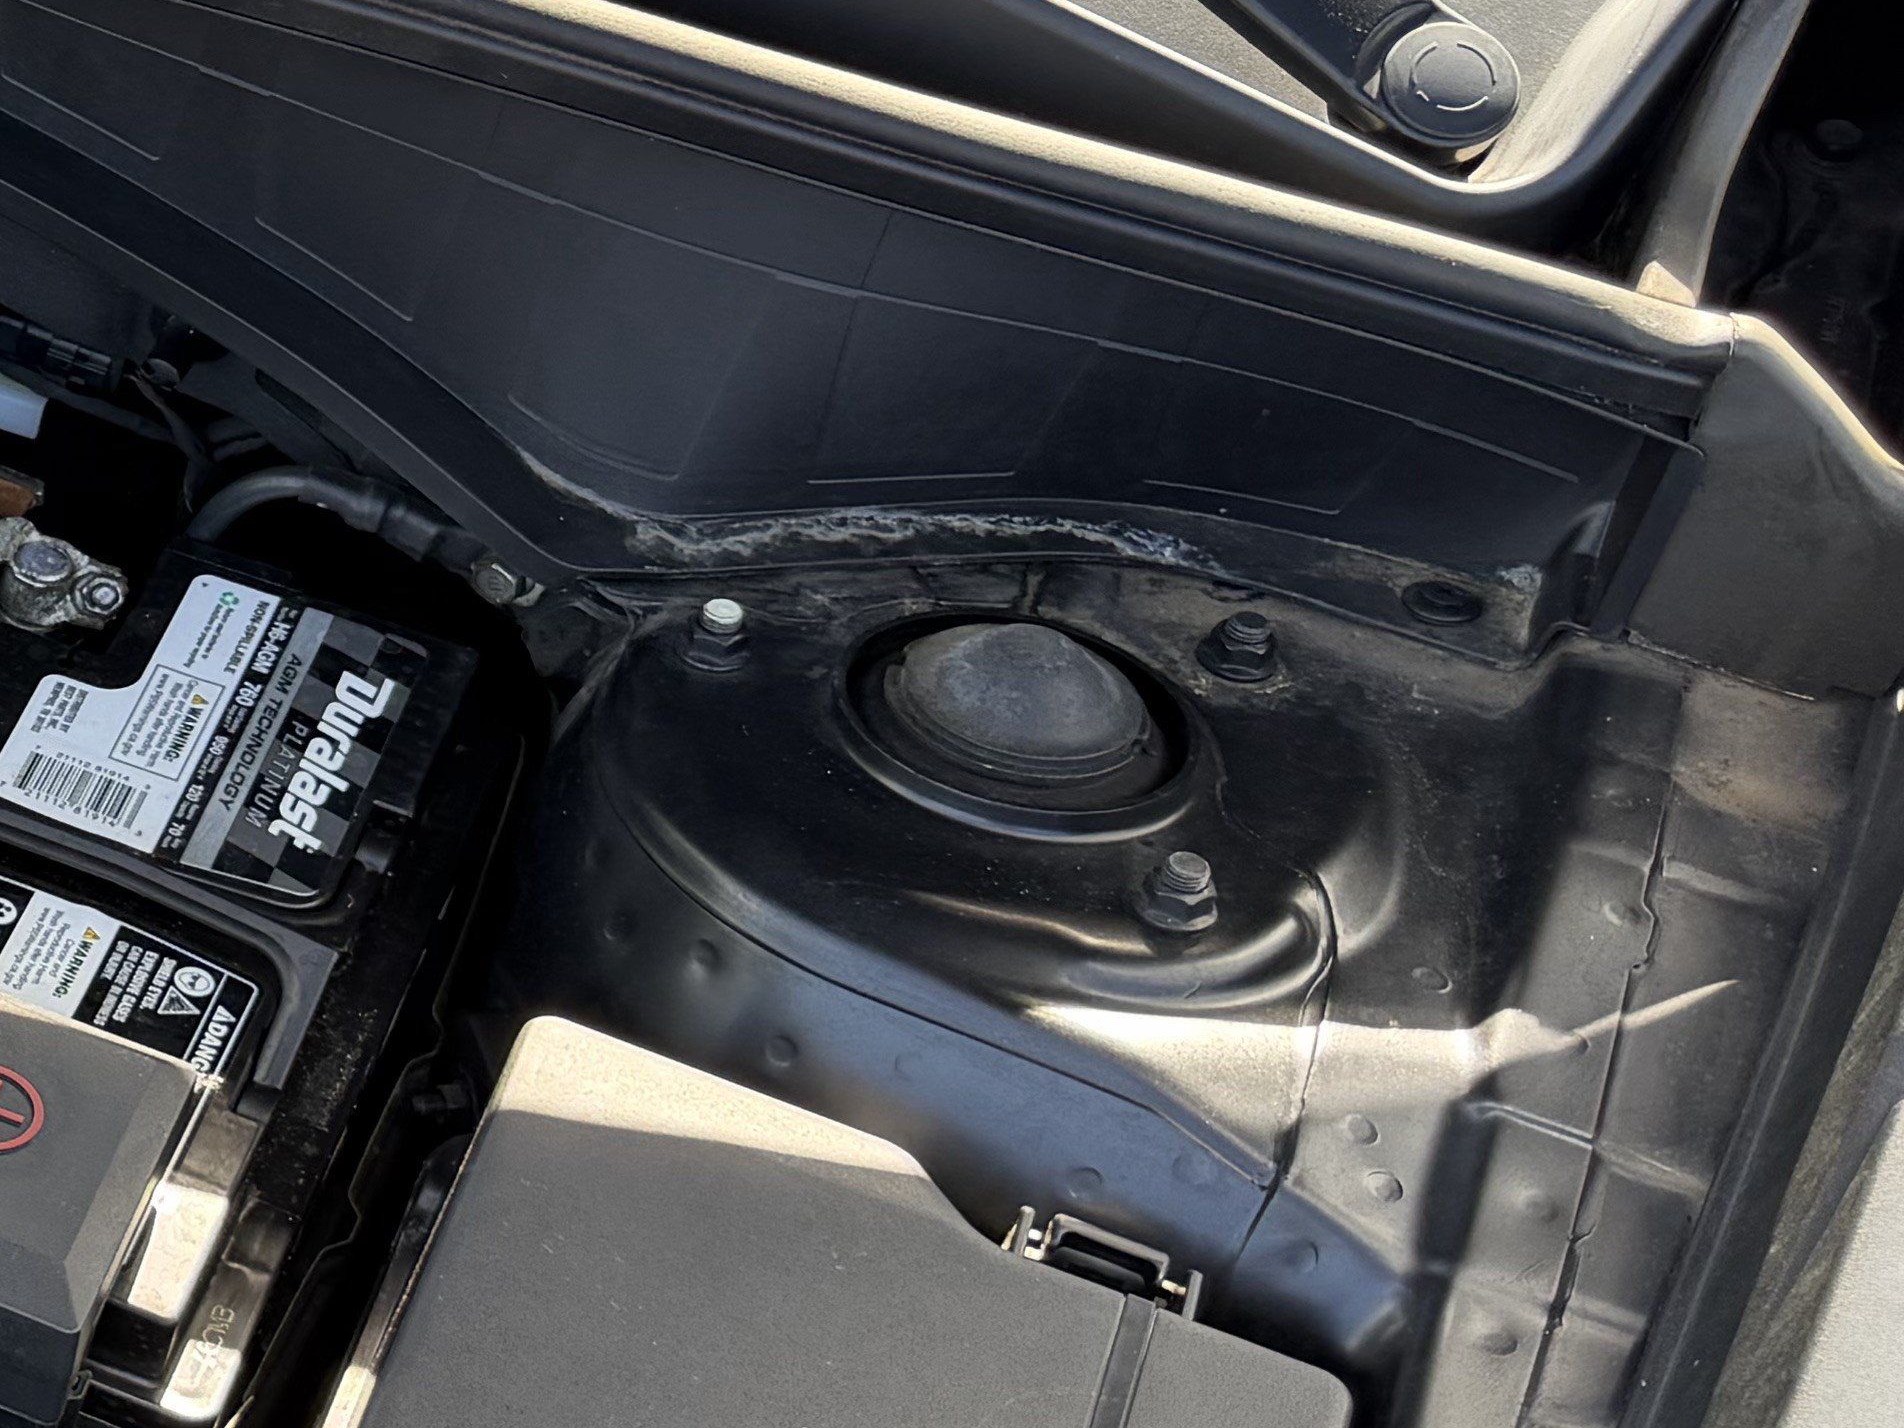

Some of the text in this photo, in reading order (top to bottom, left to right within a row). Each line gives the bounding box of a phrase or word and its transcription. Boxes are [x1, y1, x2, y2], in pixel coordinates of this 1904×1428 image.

[222, 599, 269, 675] NON-SPILLABLE
[249, 620, 291, 674] H6-AGM
[232, 679, 262, 708] 760
[272, 654, 303, 694] AGM
[161, 704, 203, 764] WARNING:
[218, 695, 283, 812] TECHNOLOGY
[246, 725, 309, 828] PLATINUM
[268, 670, 396, 854] Duralast
[183, 782, 205, 802] 120
[166, 821, 185, 837] 70
[51, 939, 93, 999] WARNING:
[113, 960, 135, 986] CAUSE
[125, 944, 144, 962] CAN
[150, 956, 177, 988] SHIELD
[111, 949, 160, 1023] EXPLOSIVE GASES
